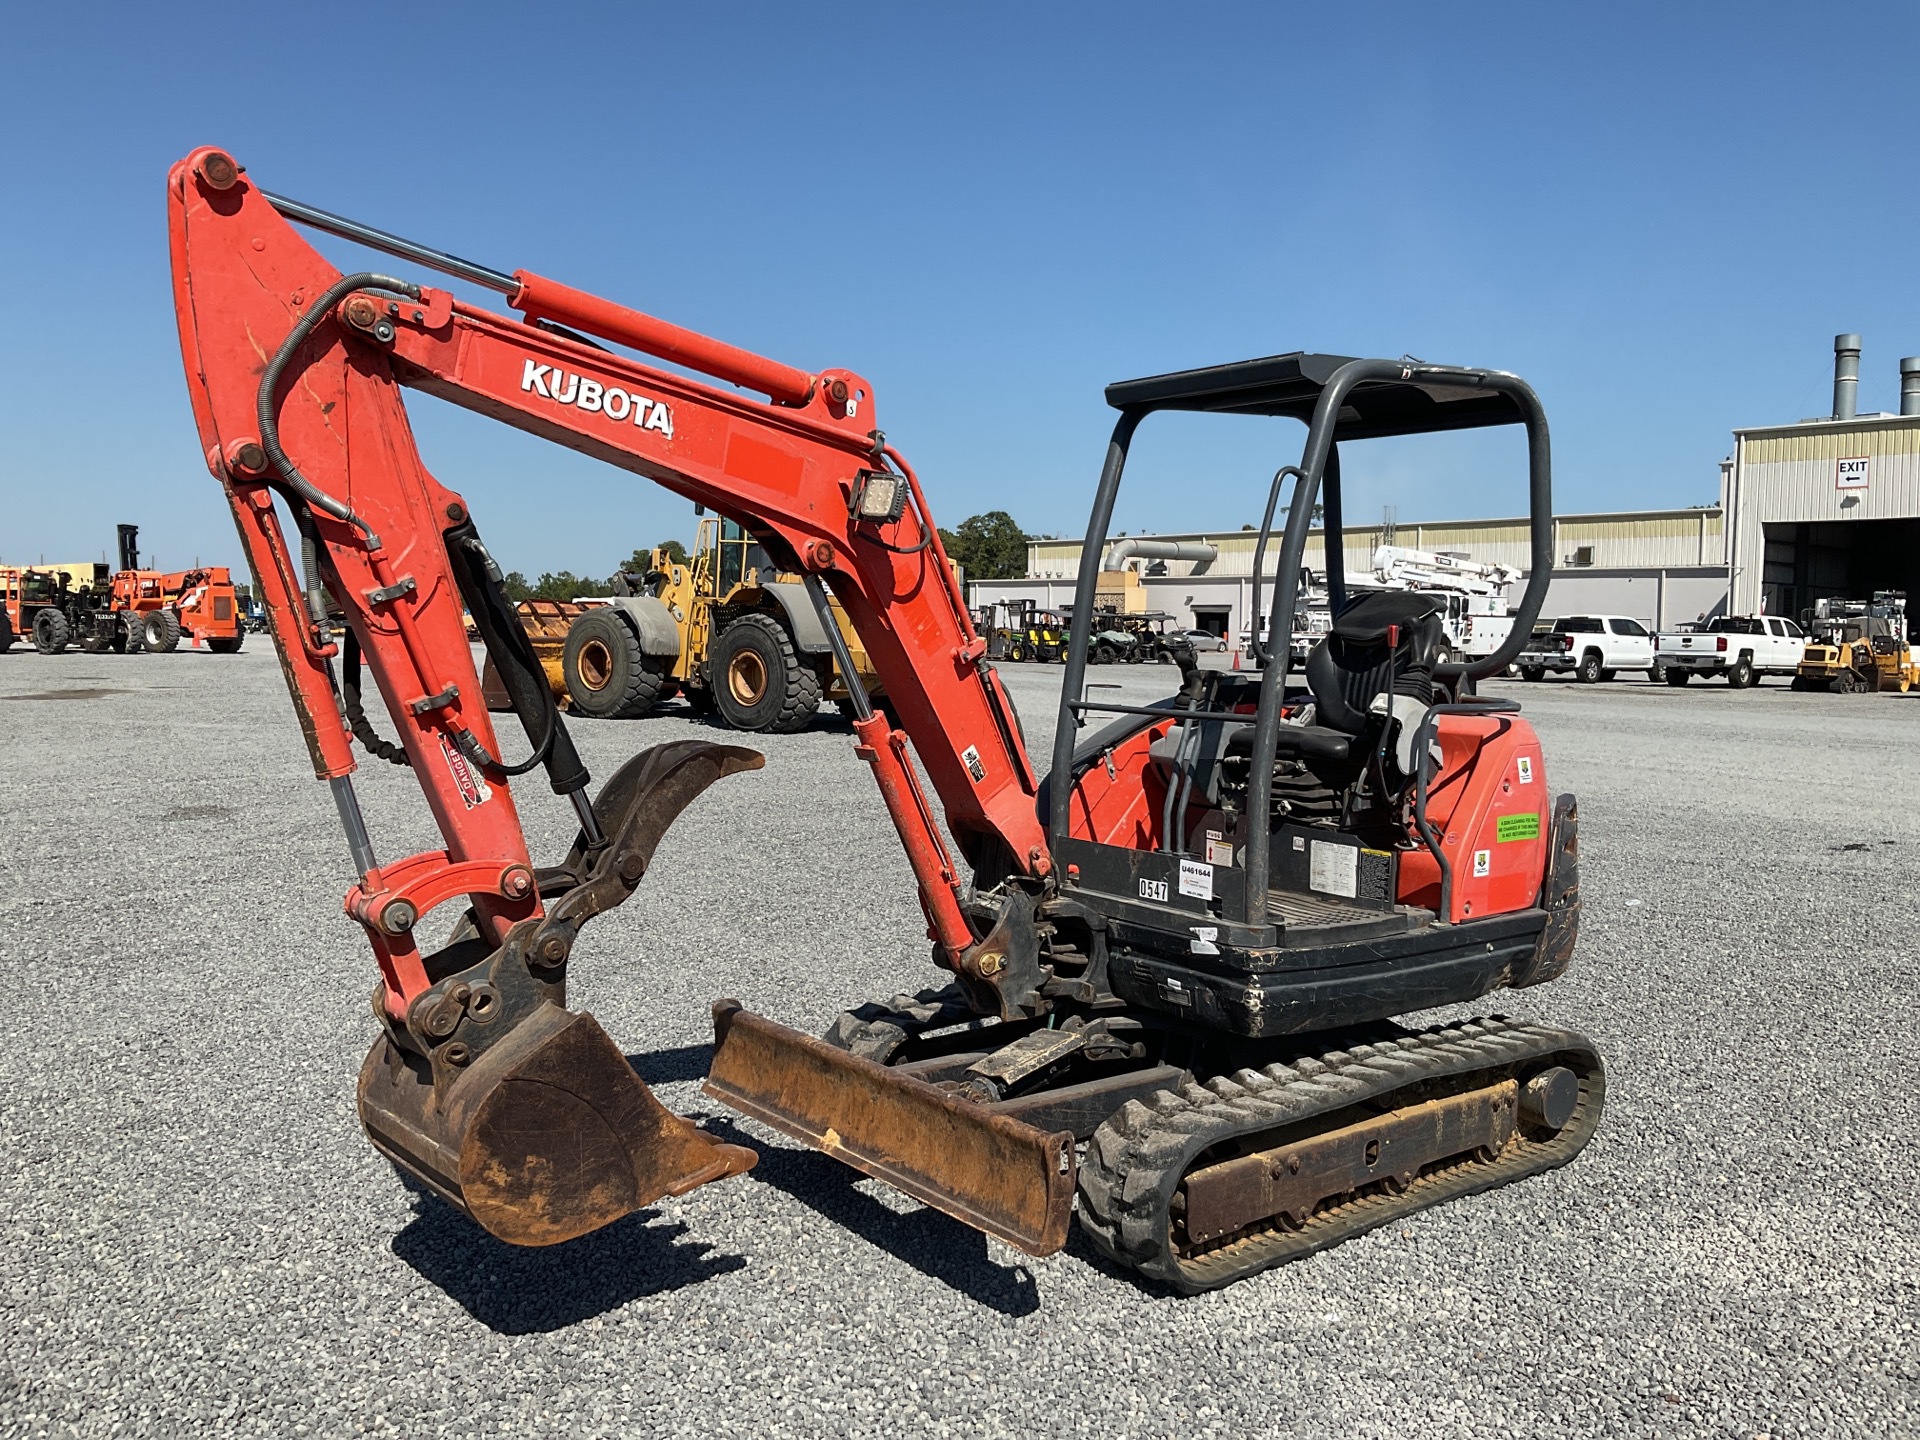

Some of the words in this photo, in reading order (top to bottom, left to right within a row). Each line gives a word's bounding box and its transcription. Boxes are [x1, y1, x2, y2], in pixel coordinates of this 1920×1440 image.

[521, 359, 671, 434] KUBOTA
[1840, 461, 1867, 472] EXIT
[449, 748, 472, 790] DANGER
[1181, 865, 1211, 877] U461644
[1141, 880, 1166, 900] 0547
